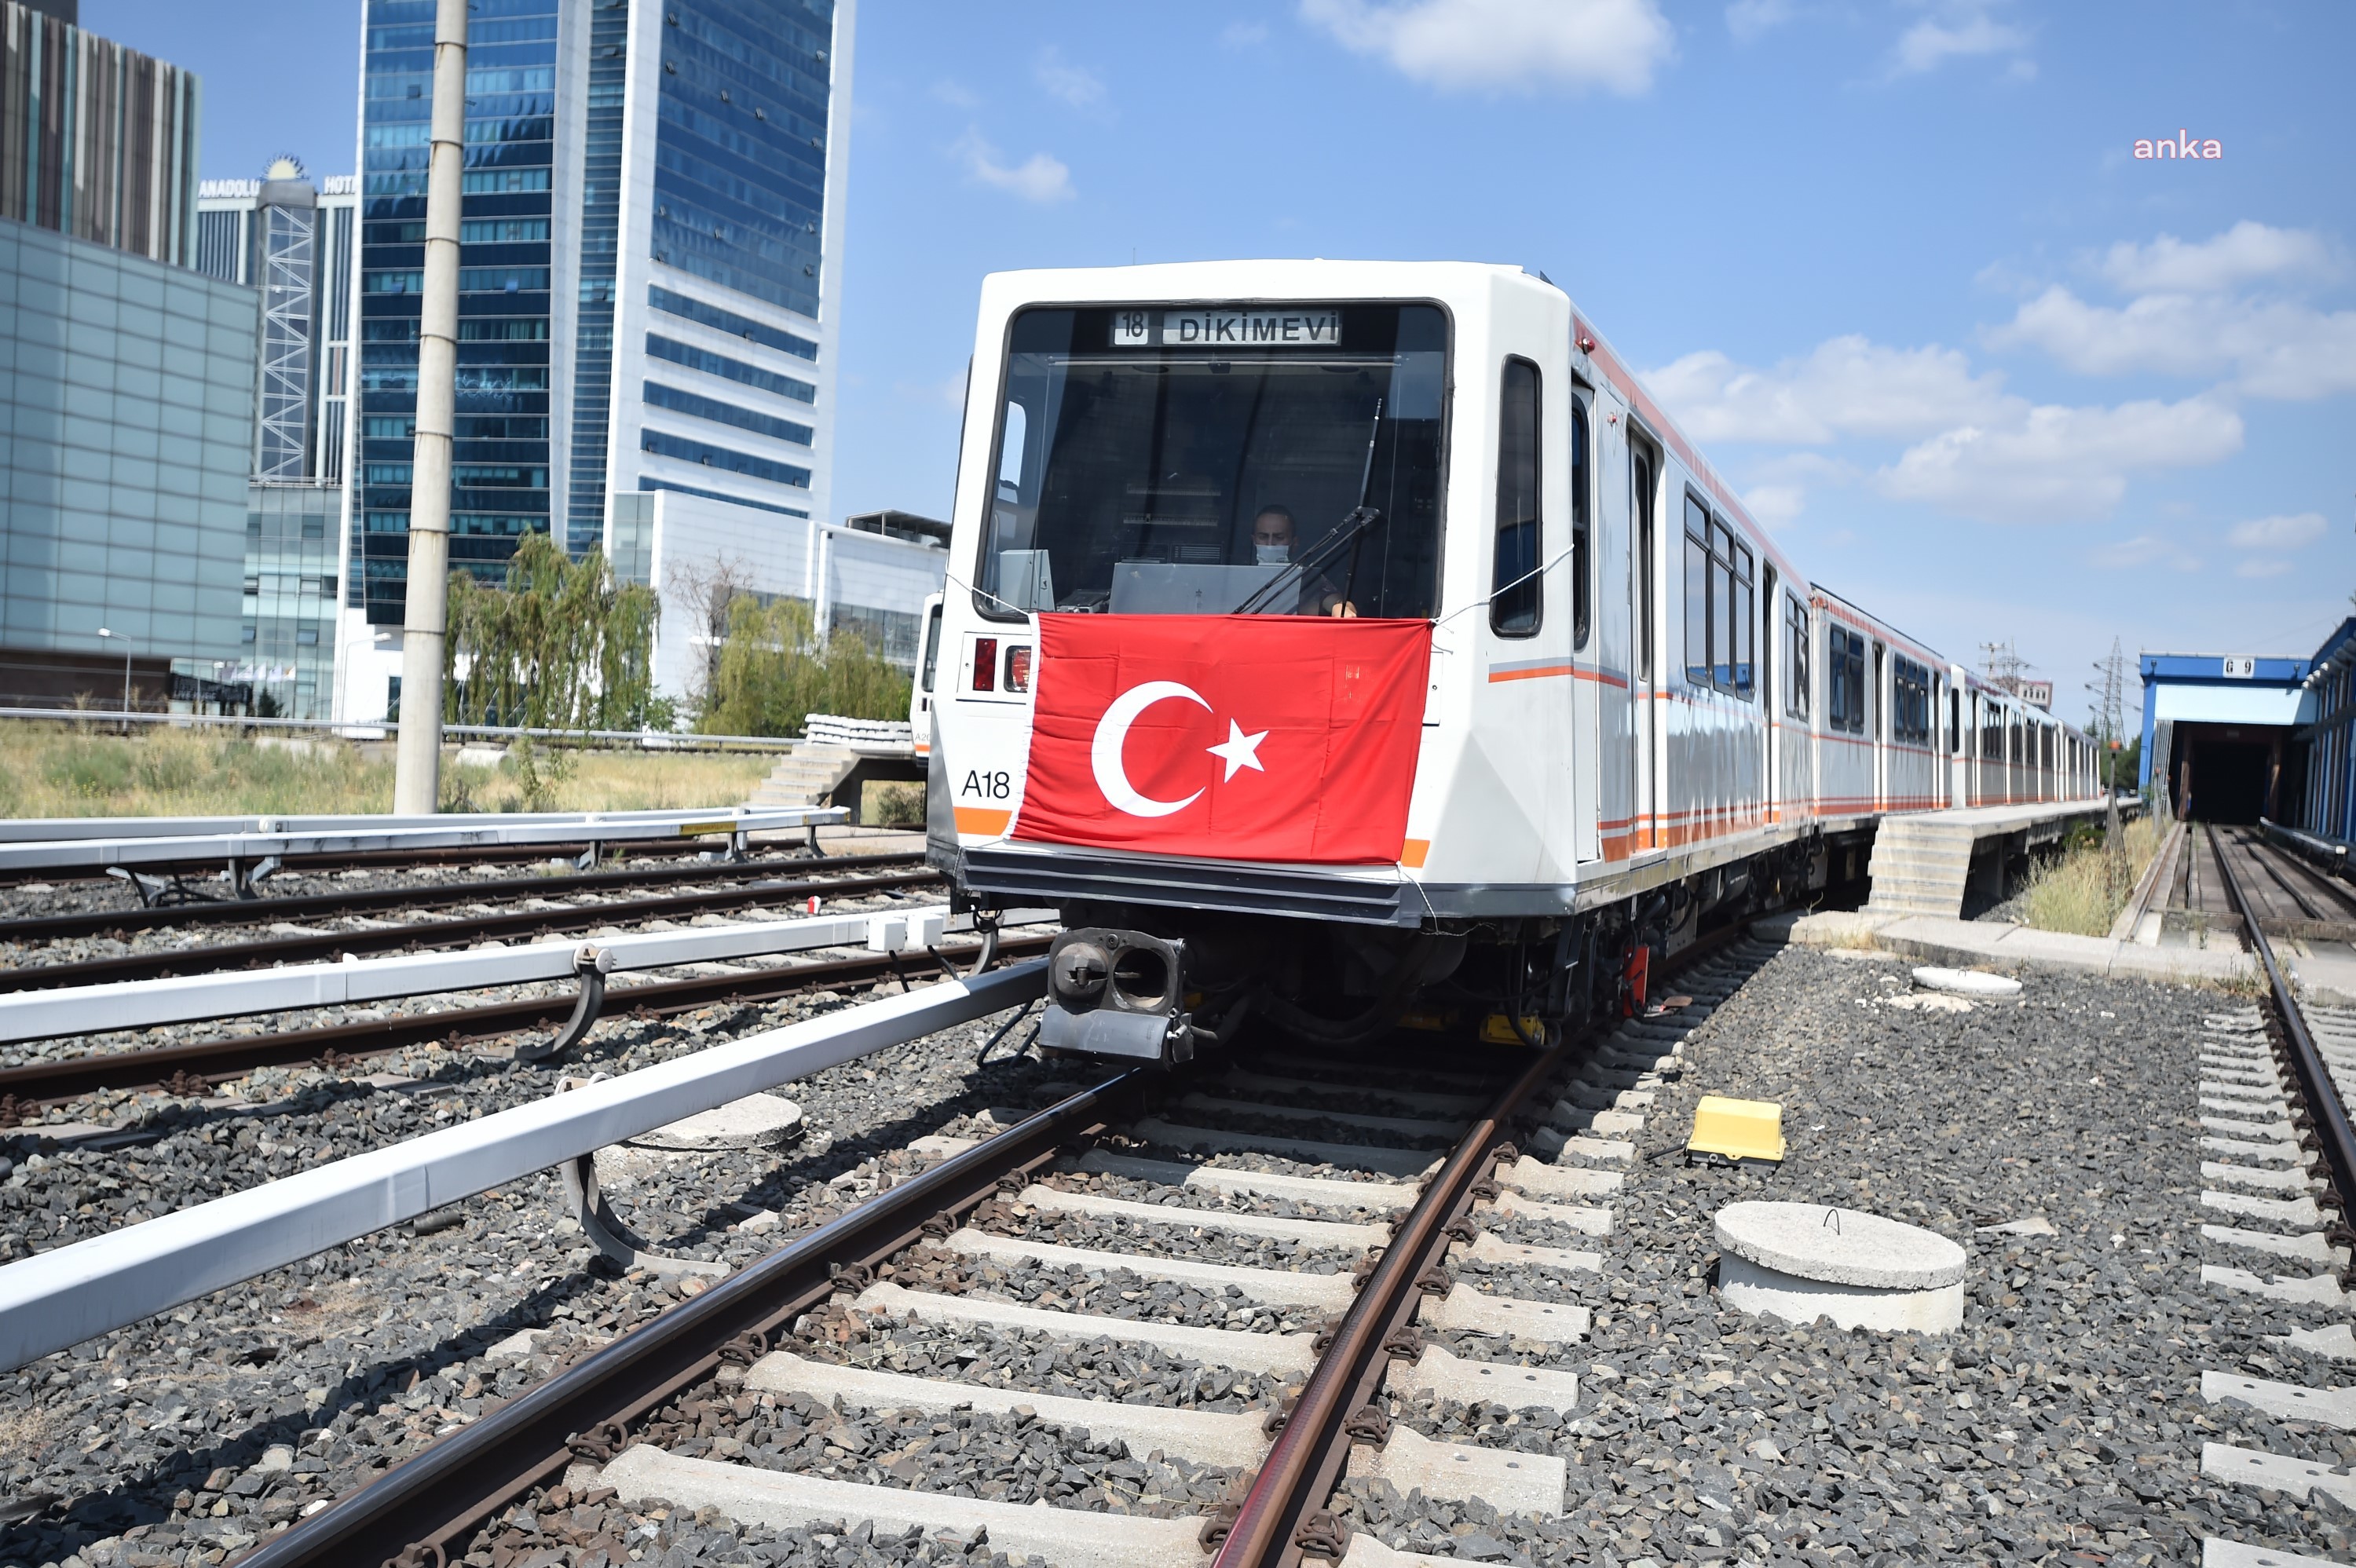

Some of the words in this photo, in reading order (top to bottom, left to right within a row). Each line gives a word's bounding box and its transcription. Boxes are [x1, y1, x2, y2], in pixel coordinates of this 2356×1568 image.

[198, 179, 260, 197] ANADOLU
[1122, 313, 1143, 337] 18
[1180, 312, 1337, 342] DİKİMEVİ
[2226, 660, 2233, 673] G
[2244, 660, 2252, 674] 9
[961, 769, 1010, 799] A18
